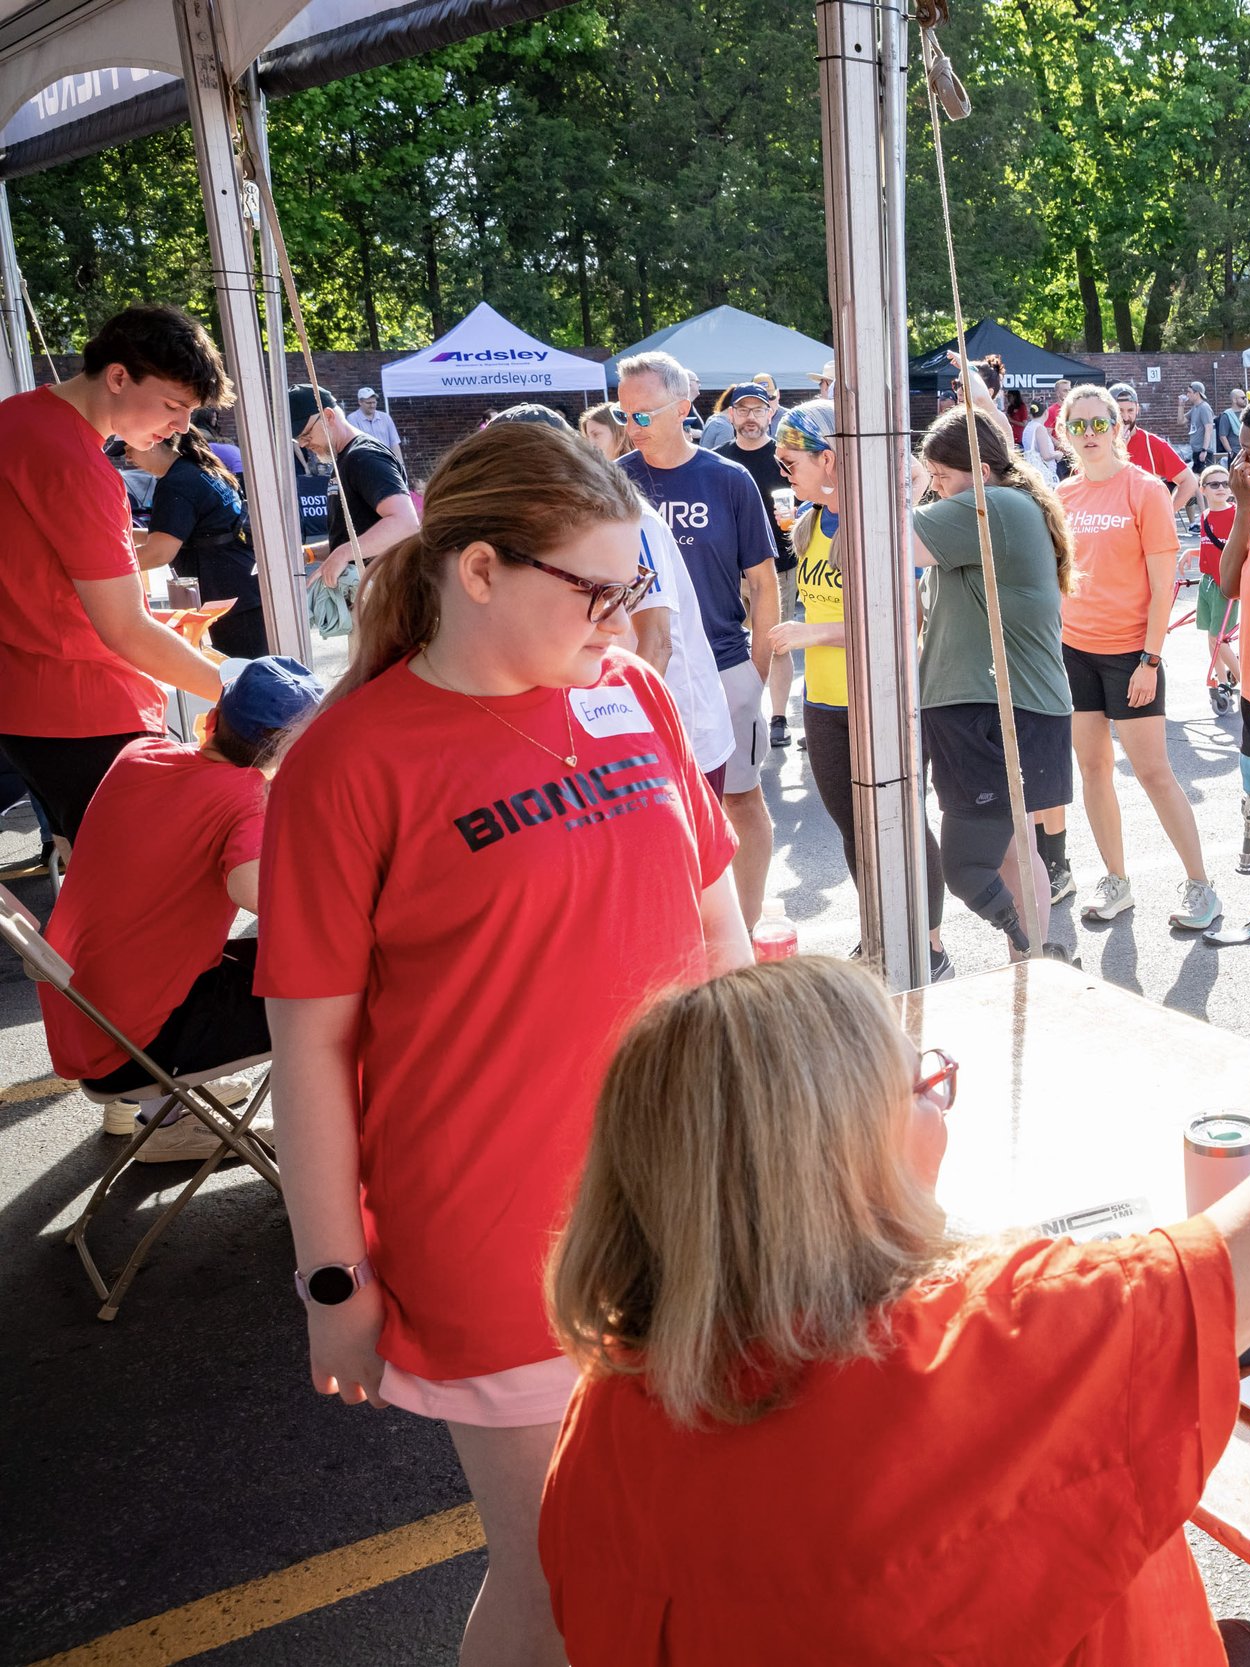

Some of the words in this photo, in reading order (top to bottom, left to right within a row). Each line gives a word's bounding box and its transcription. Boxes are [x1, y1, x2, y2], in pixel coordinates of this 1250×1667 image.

[430, 349, 548, 362] Ardsley
[441, 372, 552, 386] www.ardsley.org
[1150, 370, 1158, 379] 31
[301, 495, 327, 506] BOST
[1074, 511, 1132, 531] Hanger
[1072, 526, 1099, 534] CLINIC
[800, 588, 841, 606] Peace
[579, 701, 633, 722] Emma
[453, 753, 669, 853] BIONIC
[564, 796, 649, 832] PROJECT
